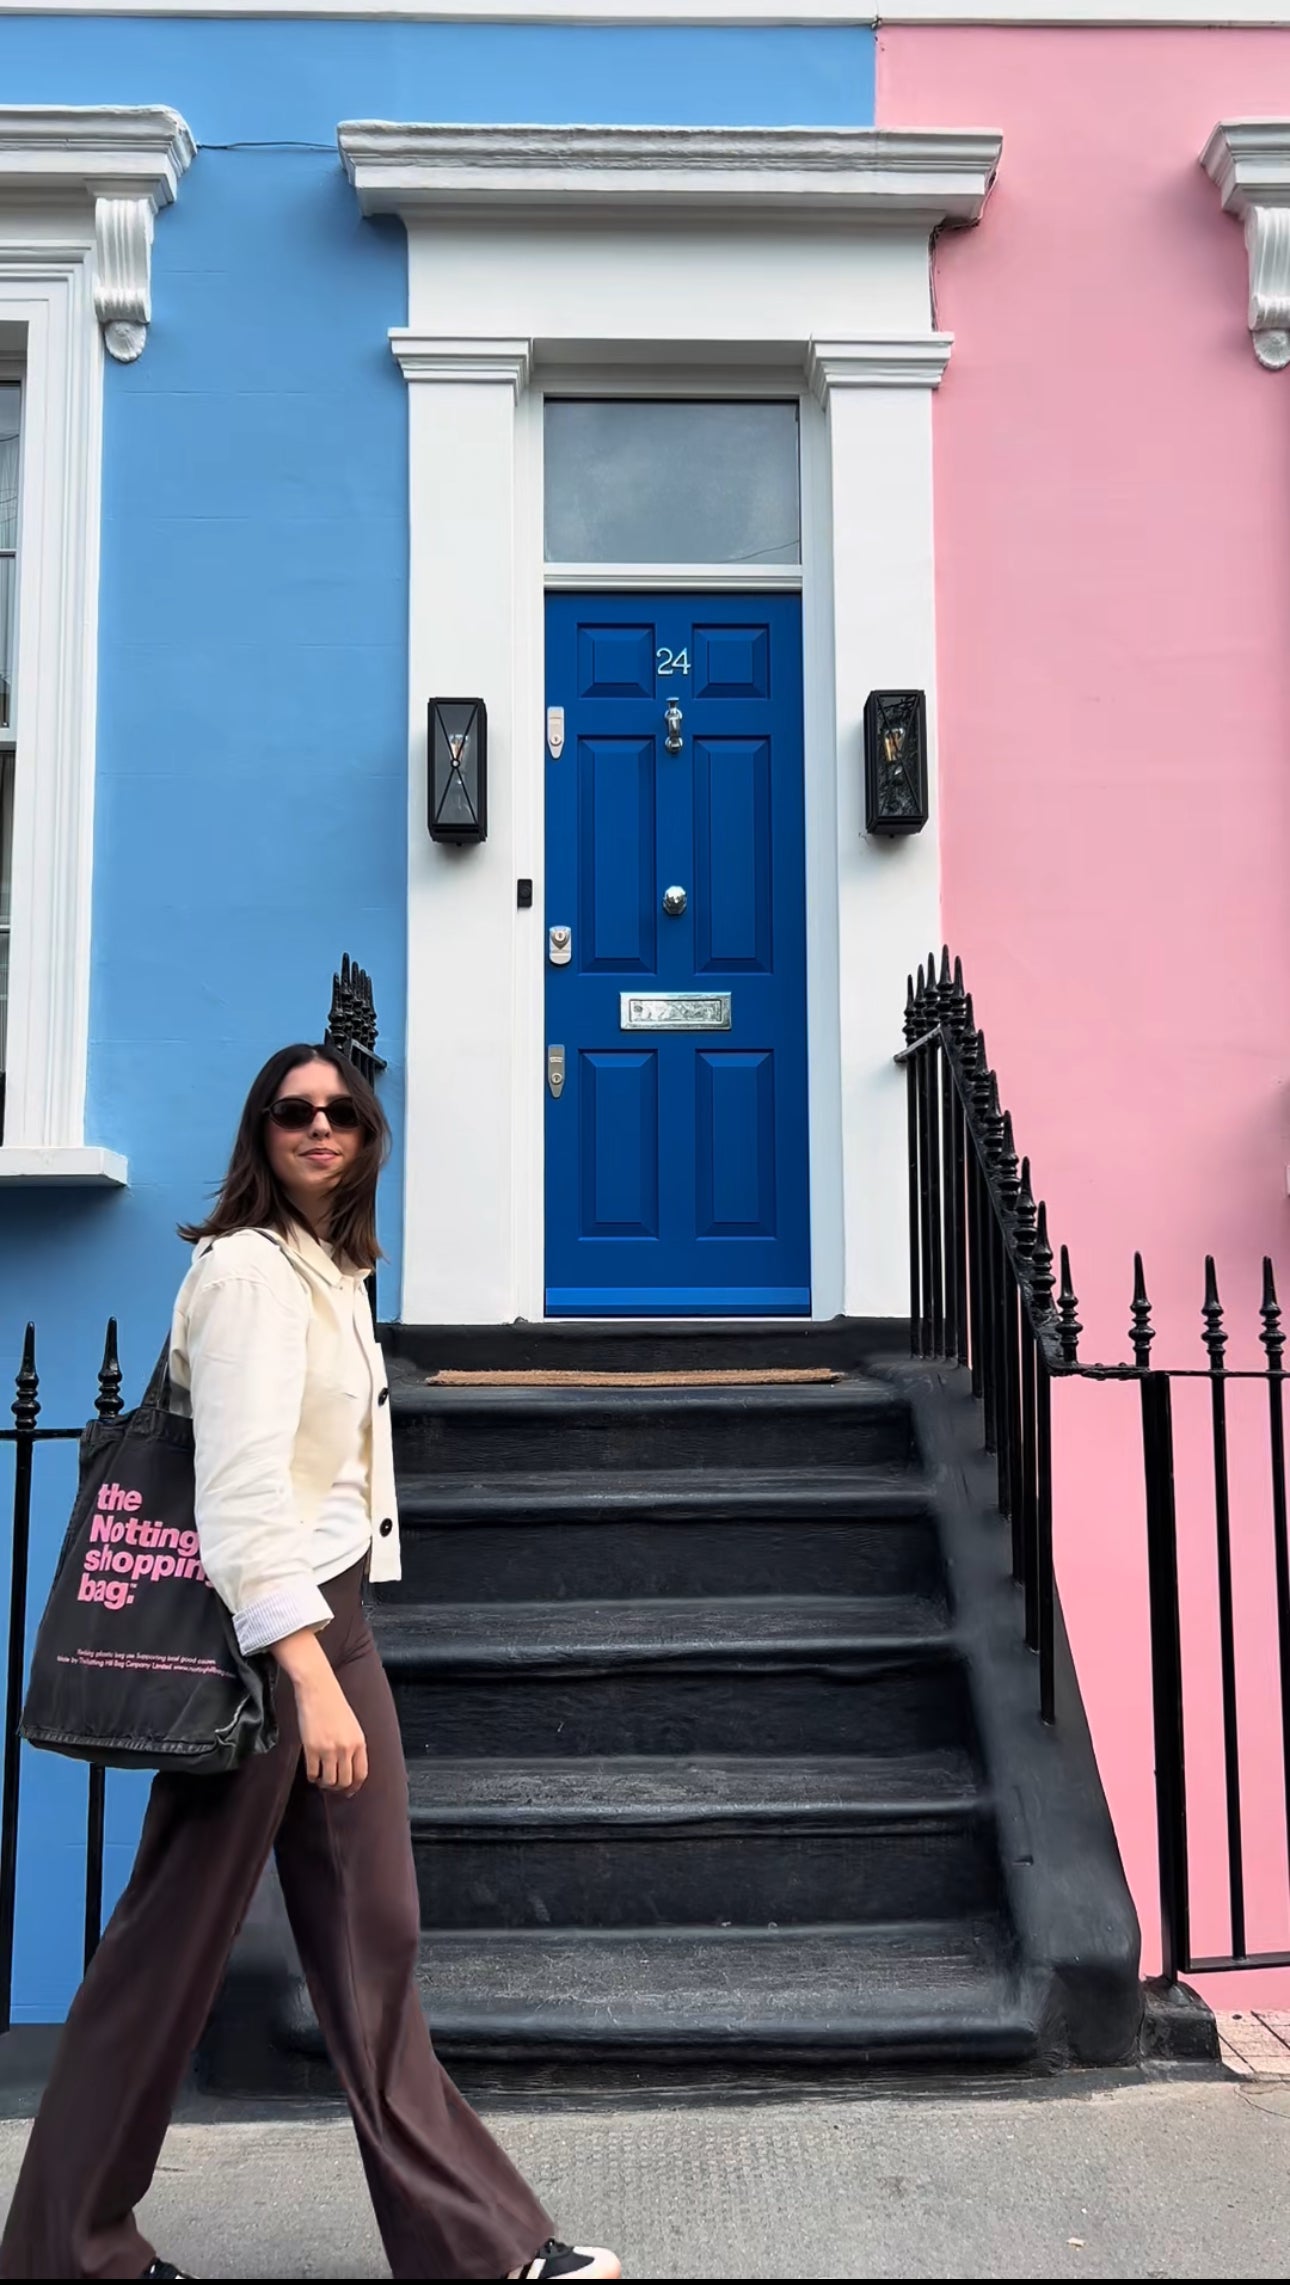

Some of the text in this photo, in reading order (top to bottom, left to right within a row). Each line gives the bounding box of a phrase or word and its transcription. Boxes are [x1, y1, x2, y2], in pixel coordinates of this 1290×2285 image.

[656, 647, 692, 675] 24
[97, 1483, 142, 1511] the
[89, 1514, 200, 1557] Notting
[83, 1544, 214, 1588] shoppin
